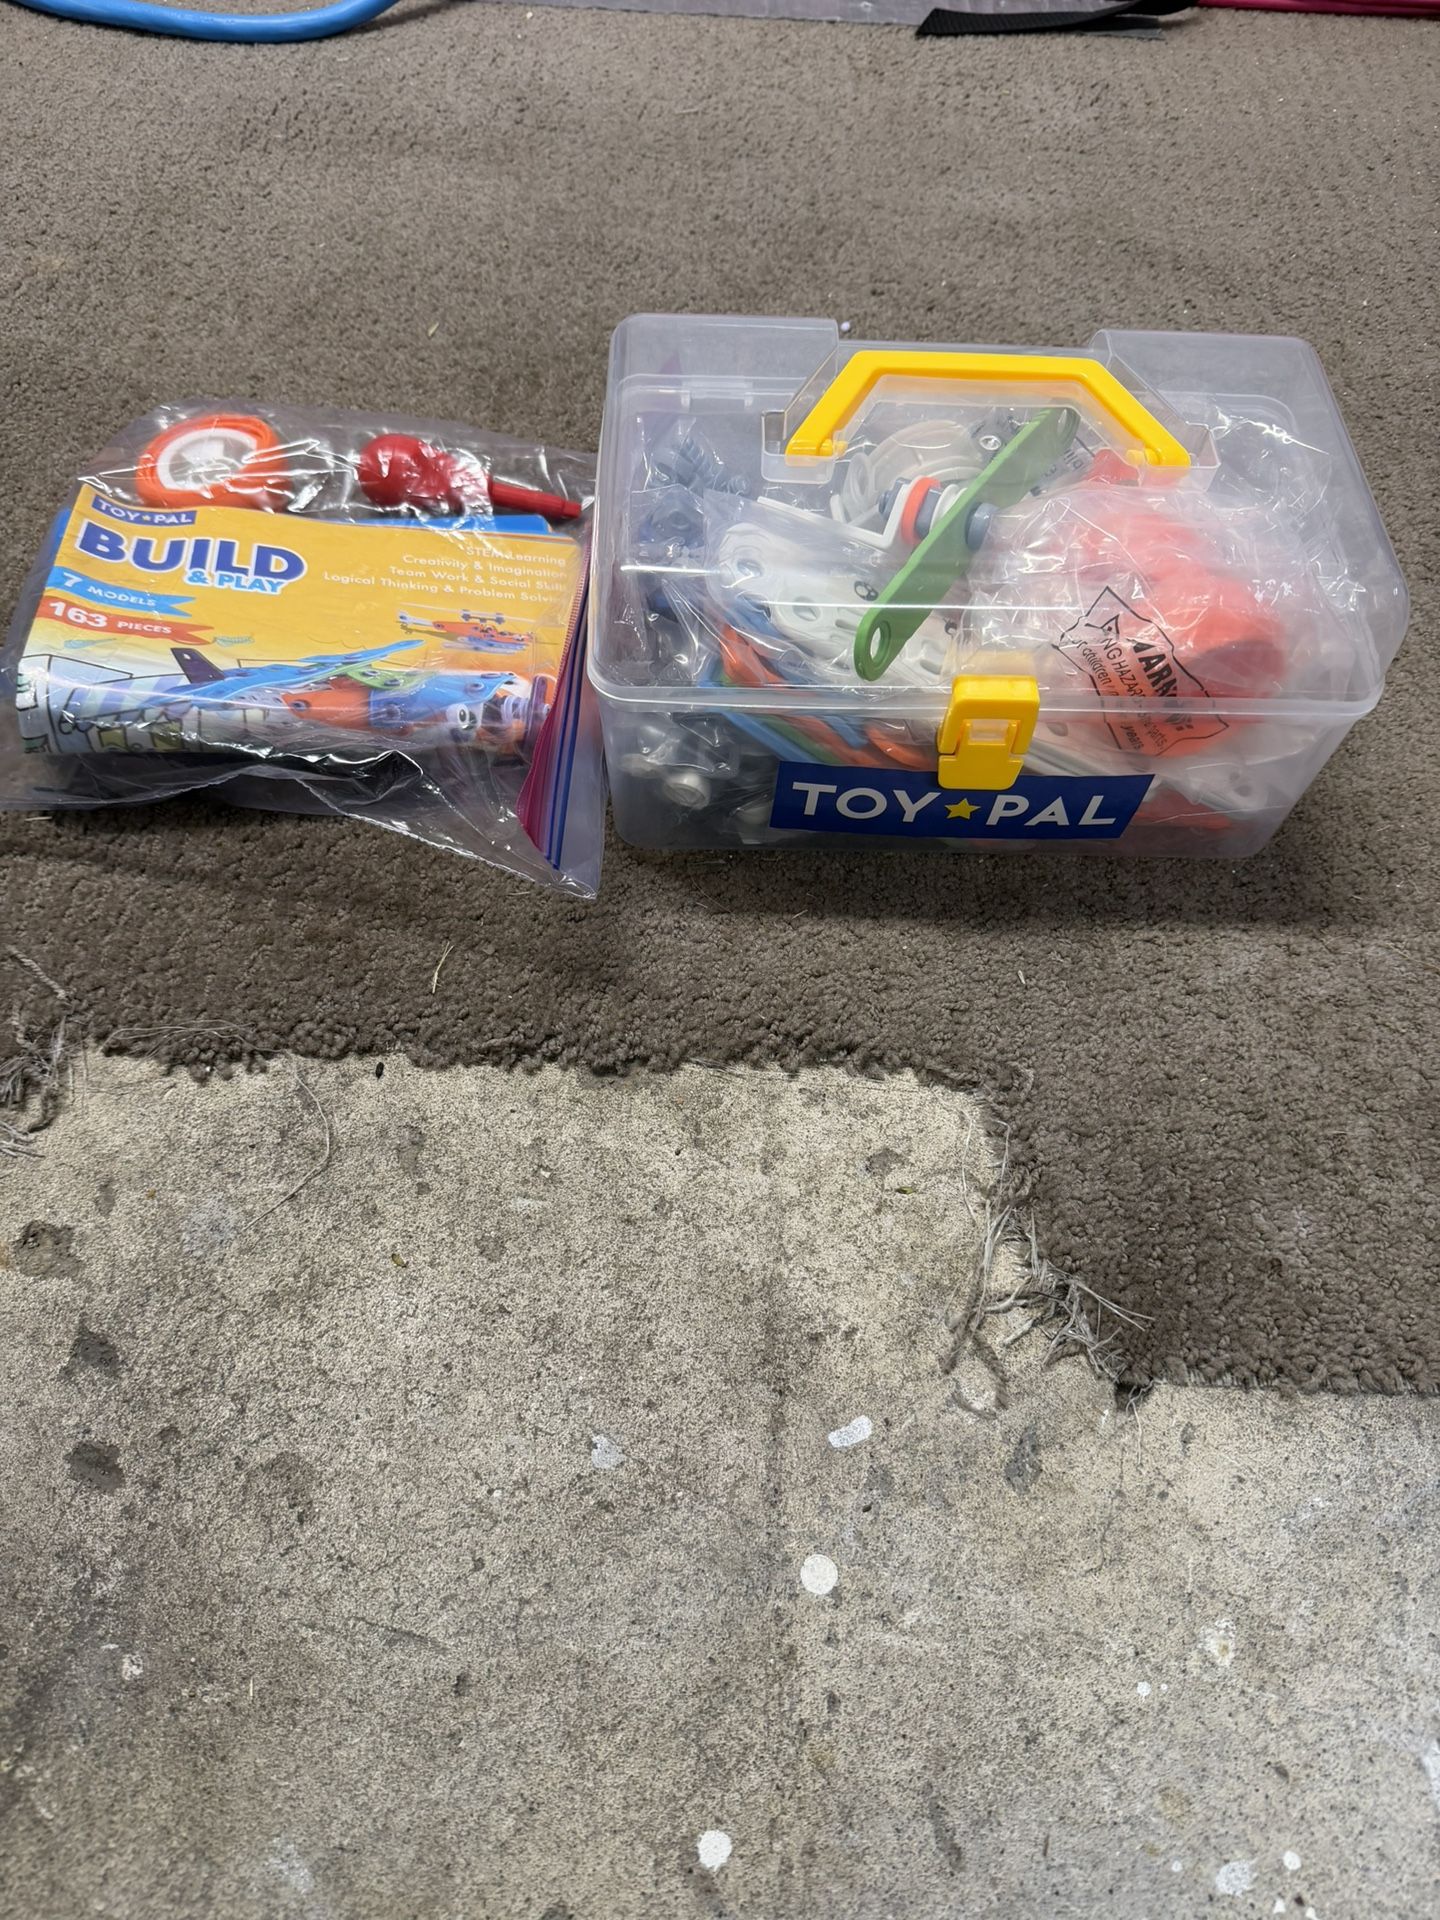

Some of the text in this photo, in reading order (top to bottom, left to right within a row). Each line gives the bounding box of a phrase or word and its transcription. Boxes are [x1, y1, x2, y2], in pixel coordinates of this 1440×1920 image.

[99, 499, 192, 524] TOY PAL
[77, 520, 306, 582] BUILD
[389, 565, 426, 578] Team
[431, 570, 469, 583] Work
[474, 575, 484, 584] &
[490, 576, 530, 588] Social
[403, 554, 567, 578] Creativity & Imagination
[62, 572, 156, 607] 7 MODELS
[185, 569, 285, 594] & PLAY
[323, 571, 375, 585] Logical
[380, 577, 438, 593] Thinking
[443, 584, 454, 593] &
[460, 586, 515, 599] Problem
[49, 601, 172, 634] 163 PIECES
[792, 781, 1117, 826] TOY PAL
